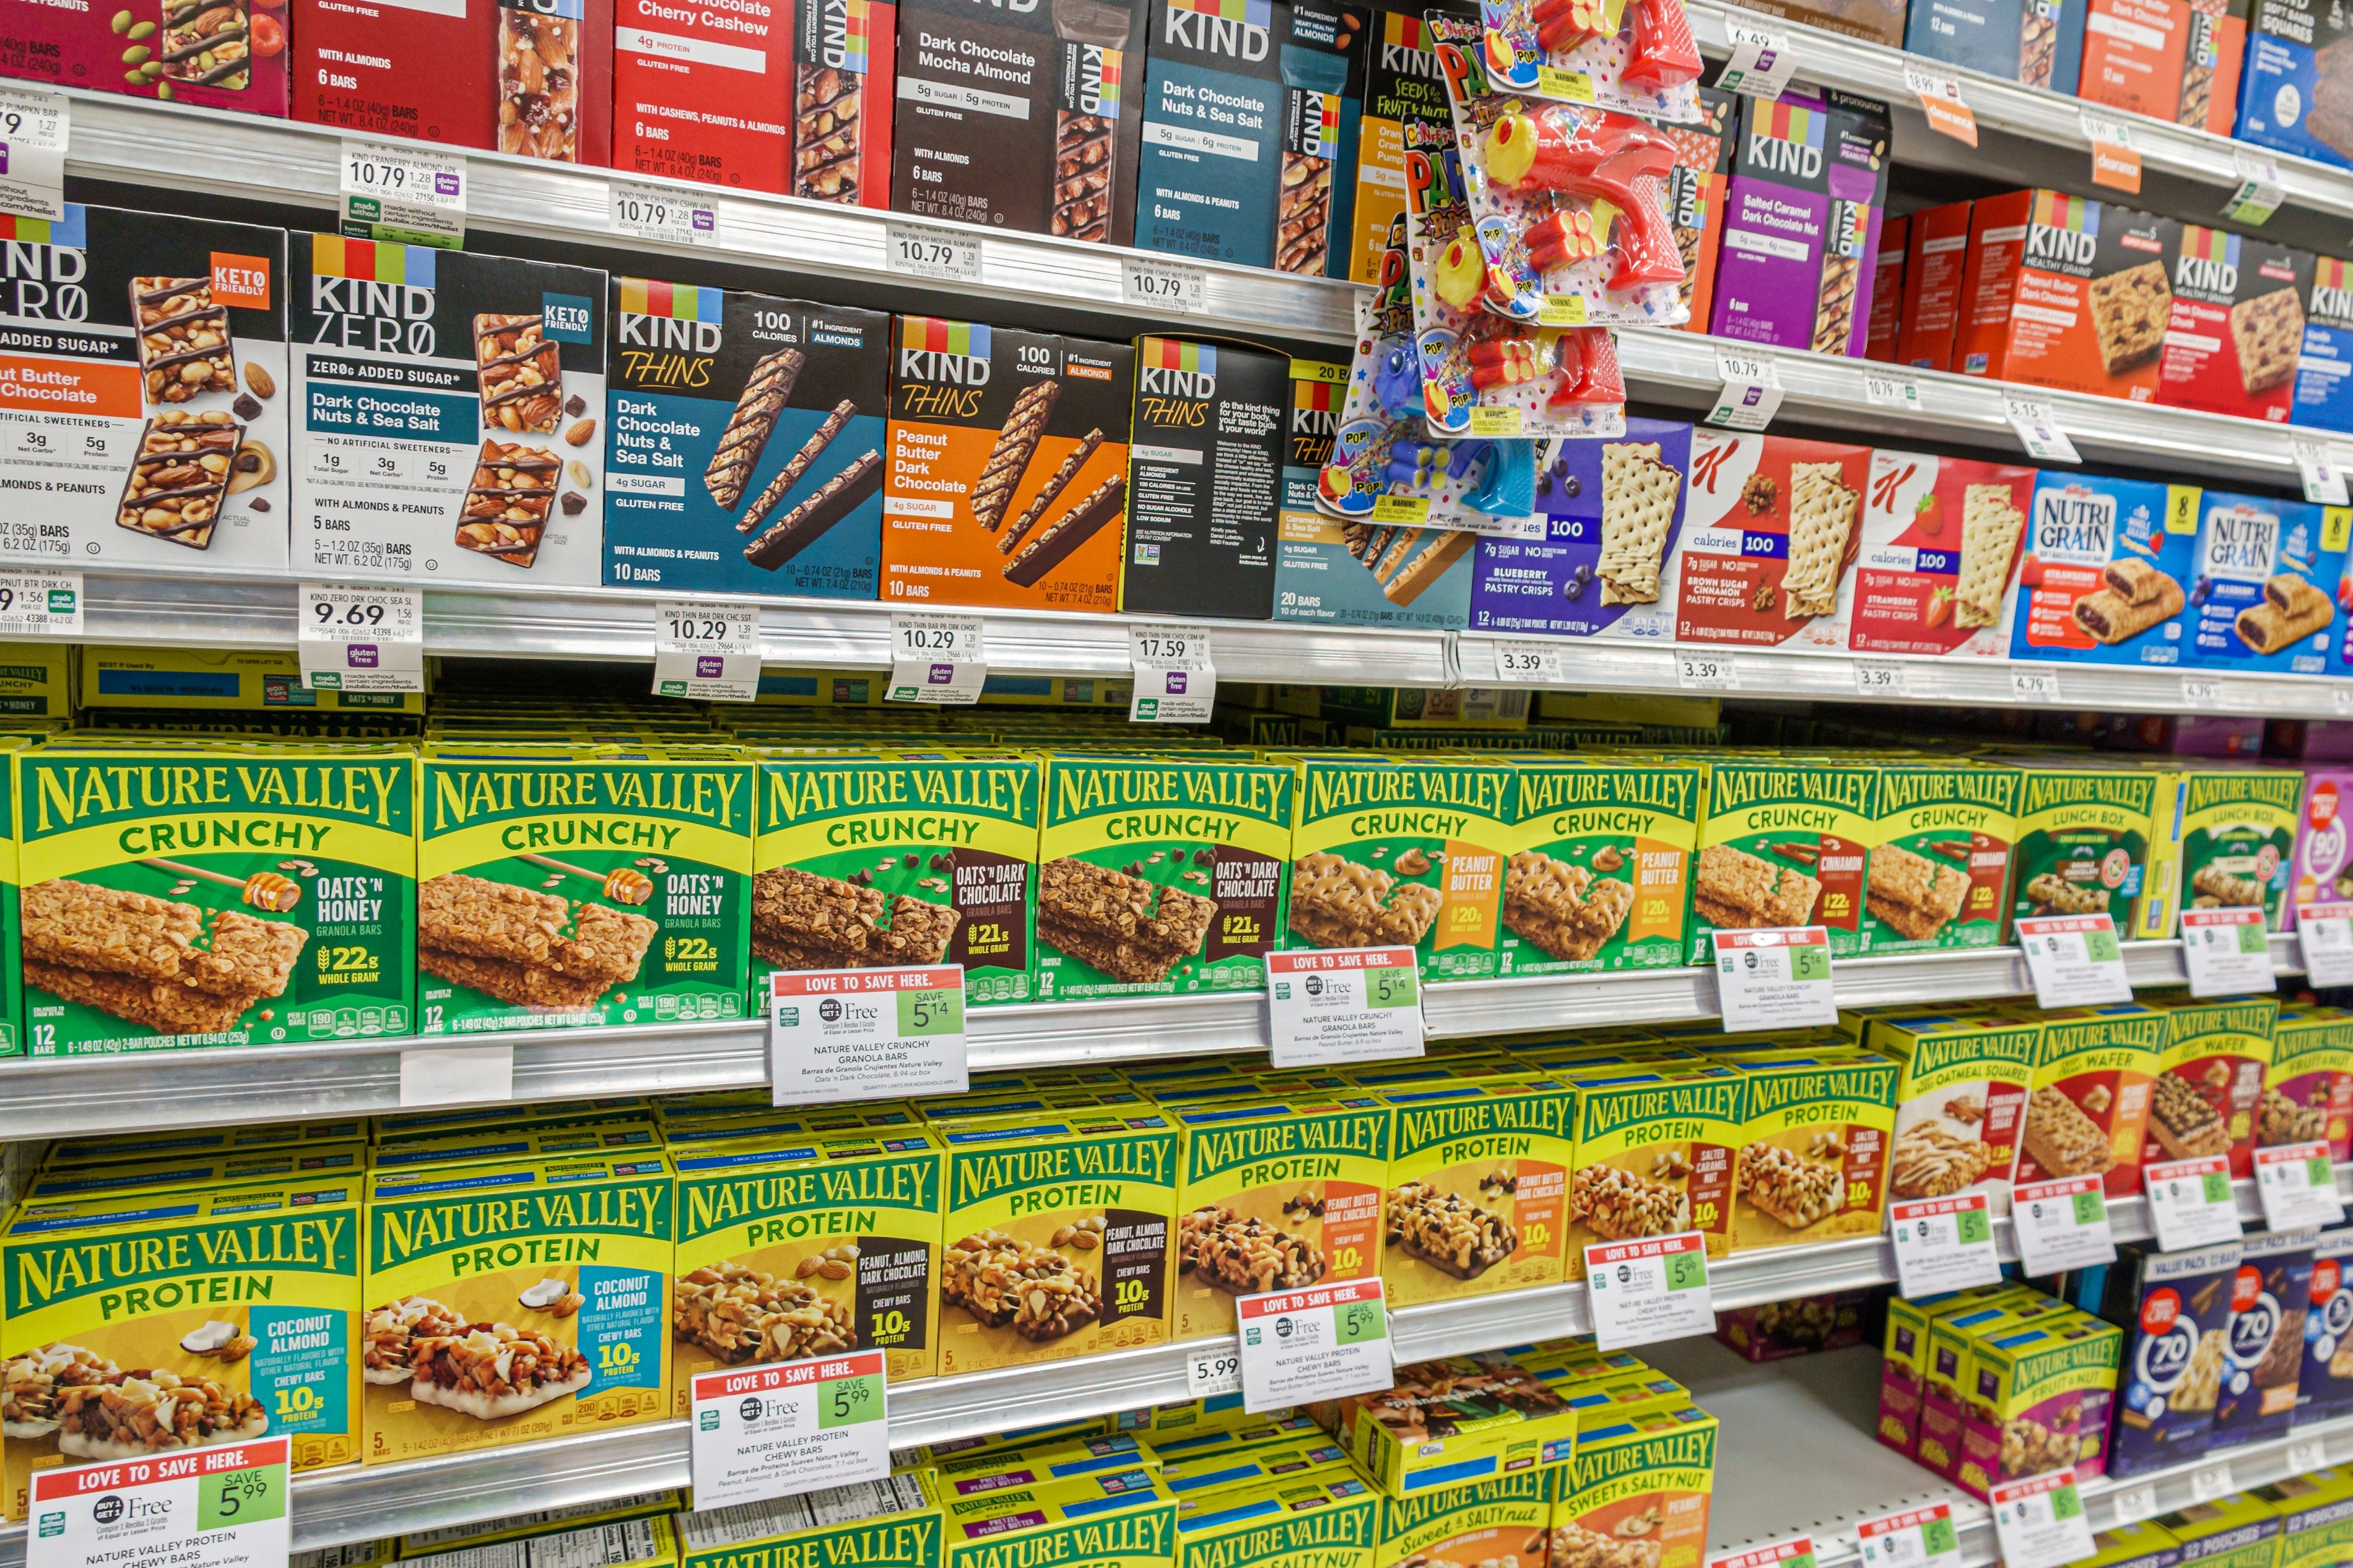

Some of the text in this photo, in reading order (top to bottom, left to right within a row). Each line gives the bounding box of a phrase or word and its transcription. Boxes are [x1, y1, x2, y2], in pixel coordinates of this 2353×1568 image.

[638, 1, 768, 36] Cherry Cashew
[1931, 17, 1941, 32] 12
[1165, 9, 1270, 62] KIND
[1517, 50, 1538, 64] POP!
[1554, 72, 1580, 84] WARNING:
[1163, 79, 1264, 112] Dark Chocolate
[637, 103, 658, 115] WITH
[659, 106, 700, 123] CASHEWS,
[702, 113, 737, 128] PEANUTS
[747, 121, 785, 135] ALMONDS
[1162, 98, 1193, 115] Nuts
[1209, 105, 1235, 123] Sea
[1238, 110, 1263, 129] Salt
[1929, 105, 1974, 130] clearance
[352, 152, 368, 161] KIND
[372, 155, 411, 166] CRANBERRY
[413, 161, 441, 171] ALMOND
[1748, 133, 1822, 179] KIND
[350, 162, 405, 188] 10.79
[410, 172, 431, 183] 1.28
[619, 191, 634, 199] KIND
[637, 193, 648, 201] DRK
[662, 197, 677, 206] CHRY
[680, 199, 698, 208] CSHW
[700, 202, 711, 210] 6PK
[1744, 194, 1811, 219] Salted Caramel
[385, 204, 436, 217] made without
[618, 199, 665, 224] 10.79
[385, 217, 459, 232] publix.com/thelist
[412, 215, 453, 225] ingredients
[1742, 209, 1819, 235] Dark Chocolate Nut
[2027, 223, 2097, 265] KIND
[2027, 256, 2061, 271] HEALTHY
[2175, 255, 2238, 294] KIND
[1134, 274, 1180, 297] 10.79
[754, 311, 791, 331] 100
[752, 329, 798, 344] CALORIES
[622, 350, 714, 387] THINS
[1725, 360, 1758, 376] 10.79
[1220, 401, 1280, 417] do the kind thing
[1220, 408, 1271, 423] for your body,
[2011, 402, 2038, 417] 5.15
[343, 439, 390, 449] ARTIFICIAL
[394, 443, 450, 453] SWEETENERS
[323, 453, 339, 466] 1g
[378, 458, 394, 470] 3g
[429, 462, 445, 474] 5g
[2043, 496, 2110, 527] NUTRI
[1551, 520, 1583, 537] 100
[1694, 535, 1737, 548] calories
[2040, 524, 2108, 552] GRAIN
[1494, 567, 1547, 579] BLUEBERRY
[1485, 584, 1553, 596] PASTRY CRISPS
[1688, 577, 1747, 589] BROWN SUGAR
[1694, 586, 1740, 597] CINNAMON
[1281, 592, 1320, 607] 20 BARS
[1868, 595, 1918, 607] STRAWBERRY
[315, 602, 385, 627] 9.69
[669, 619, 727, 645] 10.29
[1140, 639, 1185, 657] 17.59
[1505, 654, 1541, 670] 3.39
[2017, 677, 2044, 691] 4.79
[35, 765, 402, 833] NATURE VALLEY
[2052, 808, 2126, 825] LUNCH BOX
[119, 818, 332, 855] CRUNCHY
[317, 877, 366, 900] OATS
[317, 899, 383, 922] HONEY
[316, 924, 382, 937] GRANOLA BARS
[318, 971, 378, 985] WHOLE GRAIN
[806, 973, 933, 991] LOVE TO SAVE HERE.
[916, 992, 944, 1002] SAVE
[845, 1003, 878, 1020] Free
[33, 1024, 55, 1046] 12
[814, 1041, 930, 1054] NATURE VALLEY CRUNCHY
[839, 1054, 883, 1063] GRANOLA
[864, 1063, 897, 1072] Crujientes
[923, 1060, 943, 1068] Valley
[858, 1072, 892, 1080] Chocolate,
[1625, 1122, 1703, 1146] PROTEIN
[1276, 1348, 1360, 1367] NATURE VALLEY PROTEIN
[2154, 1335, 2188, 1364] 70
[1198, 1359, 1239, 1379] 5.99
[1297, 1360, 1341, 1372] CHEWY BARS
[2032, 1375, 2067, 1400] FRUIT
[2076, 1371, 2100, 1385] NUT
[1568, 1484, 1617, 1517] SWEET
[1632, 1473, 1672, 1492] SALTY
[1676, 1471, 1705, 1488] NUT
[978, 1518, 1035, 1535] PEANUT BUTTER
[989, 1516, 1017, 1525] PRETZEL
